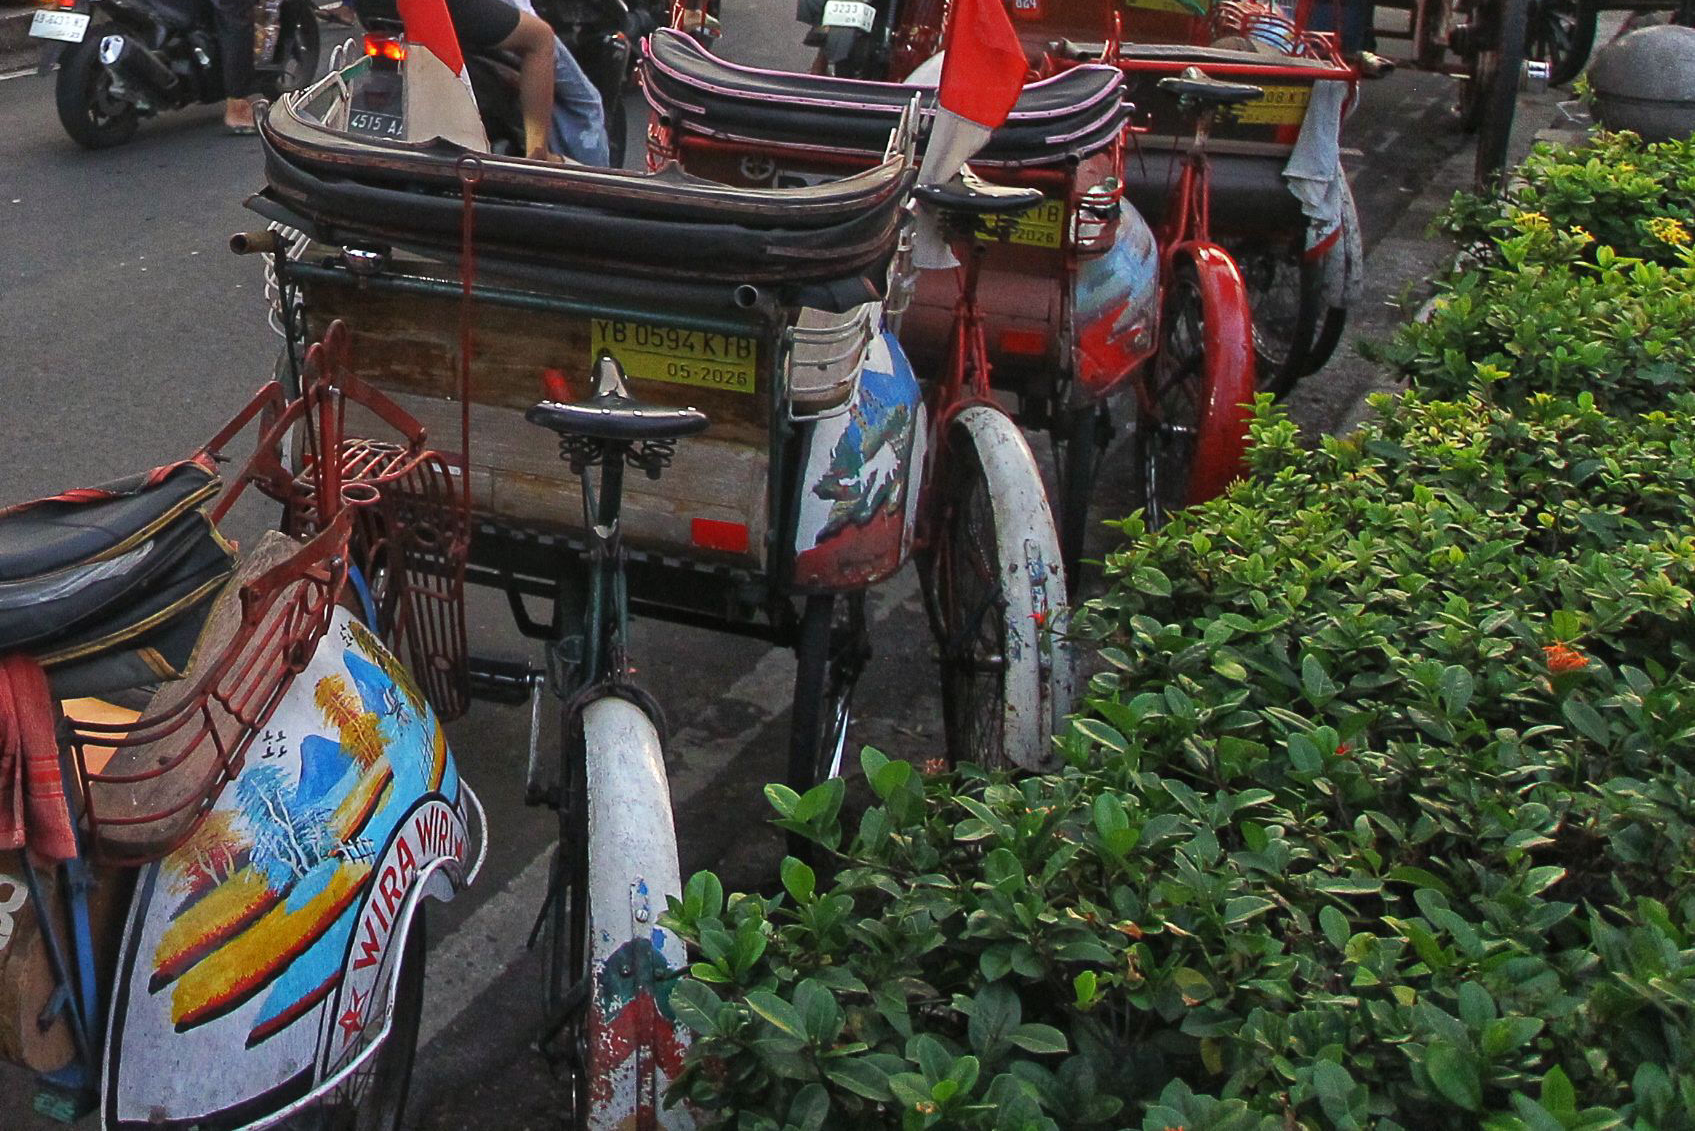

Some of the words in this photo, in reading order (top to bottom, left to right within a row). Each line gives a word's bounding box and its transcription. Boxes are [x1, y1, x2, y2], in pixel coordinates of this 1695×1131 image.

[351, 114, 383, 131] 4515
[597, 320, 627, 343] YB
[635, 324, 696, 352] 0594
[353, 836, 416, 971] WIRA
